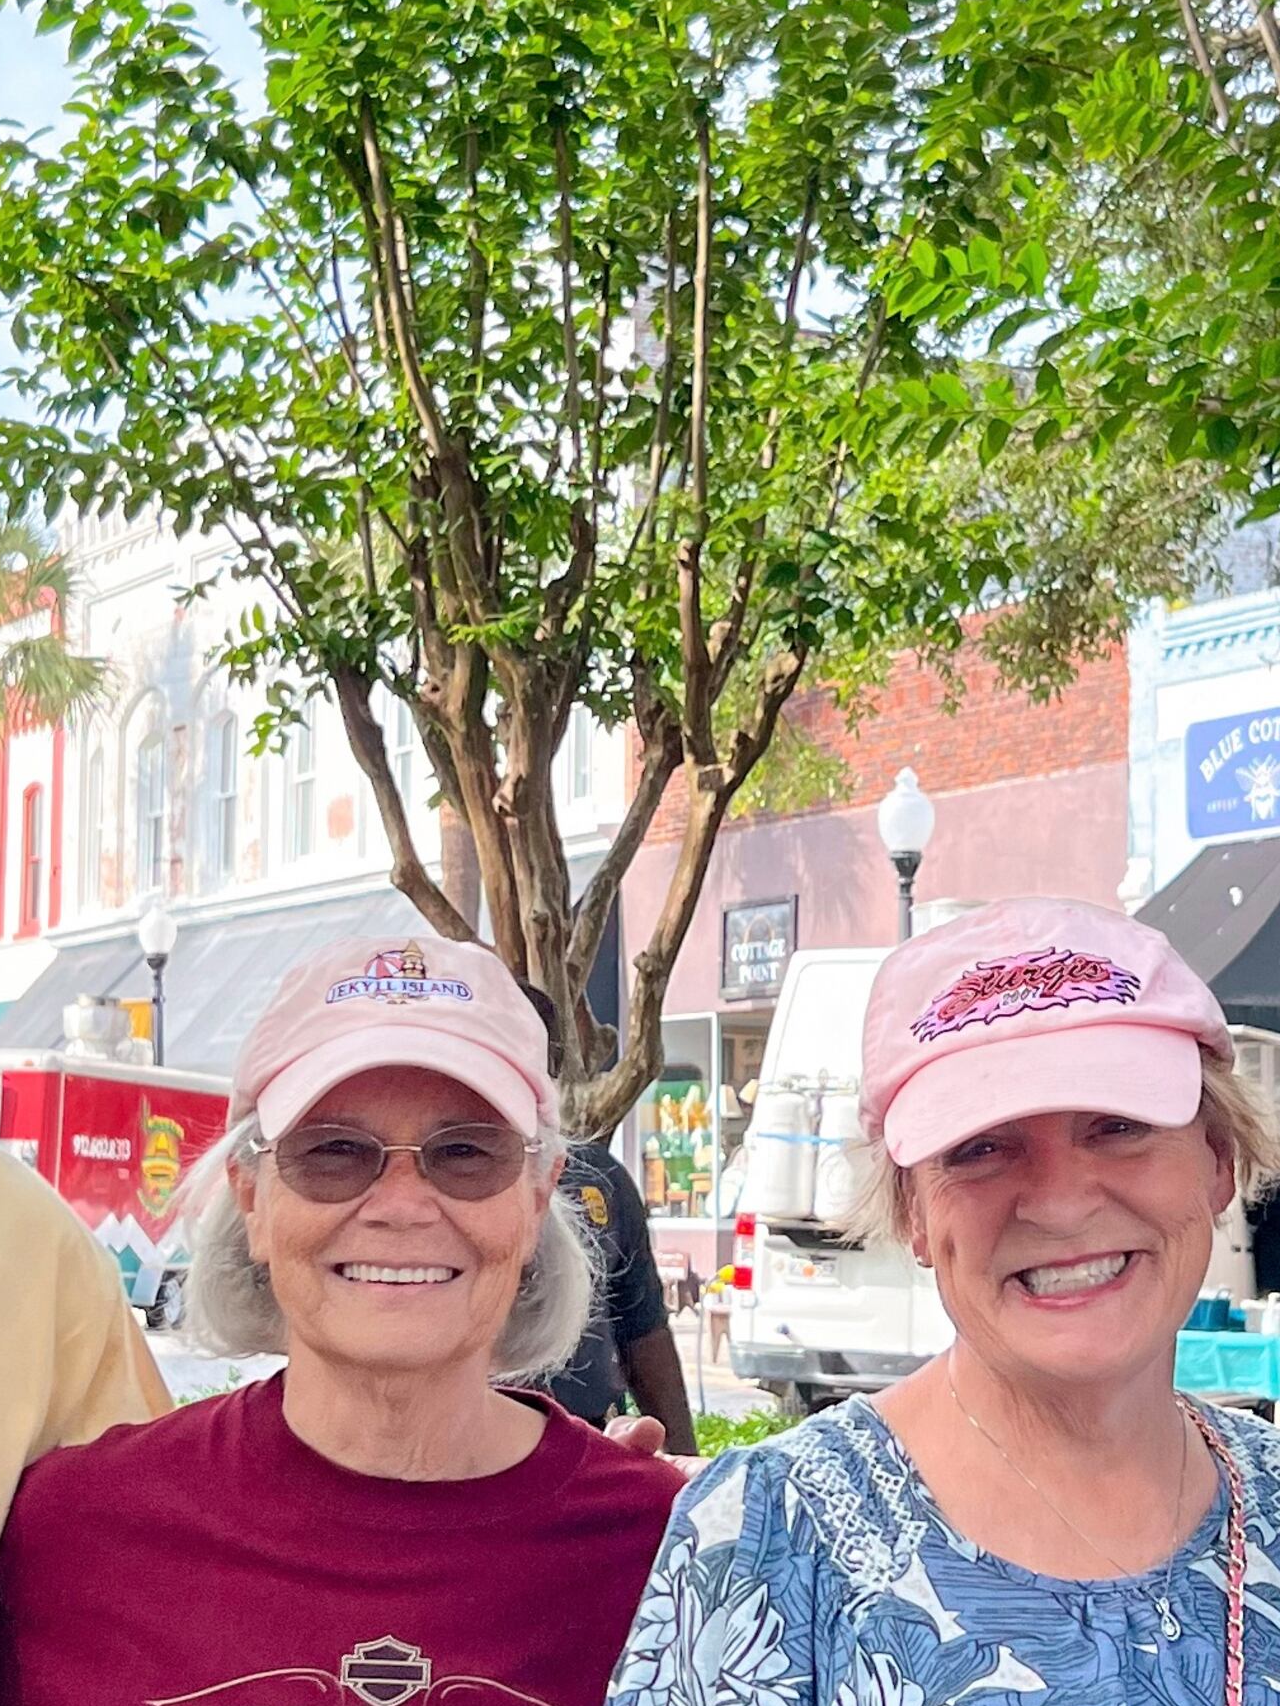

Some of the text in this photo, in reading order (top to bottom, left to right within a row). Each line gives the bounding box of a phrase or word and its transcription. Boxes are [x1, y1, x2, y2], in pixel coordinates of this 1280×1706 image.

[1199, 727, 1245, 783] BLUE
[331, 979, 470, 1000] JEKYLL ISLAND
[739, 961, 780, 984] POINT
[937, 956, 1112, 1020] Sturgis
